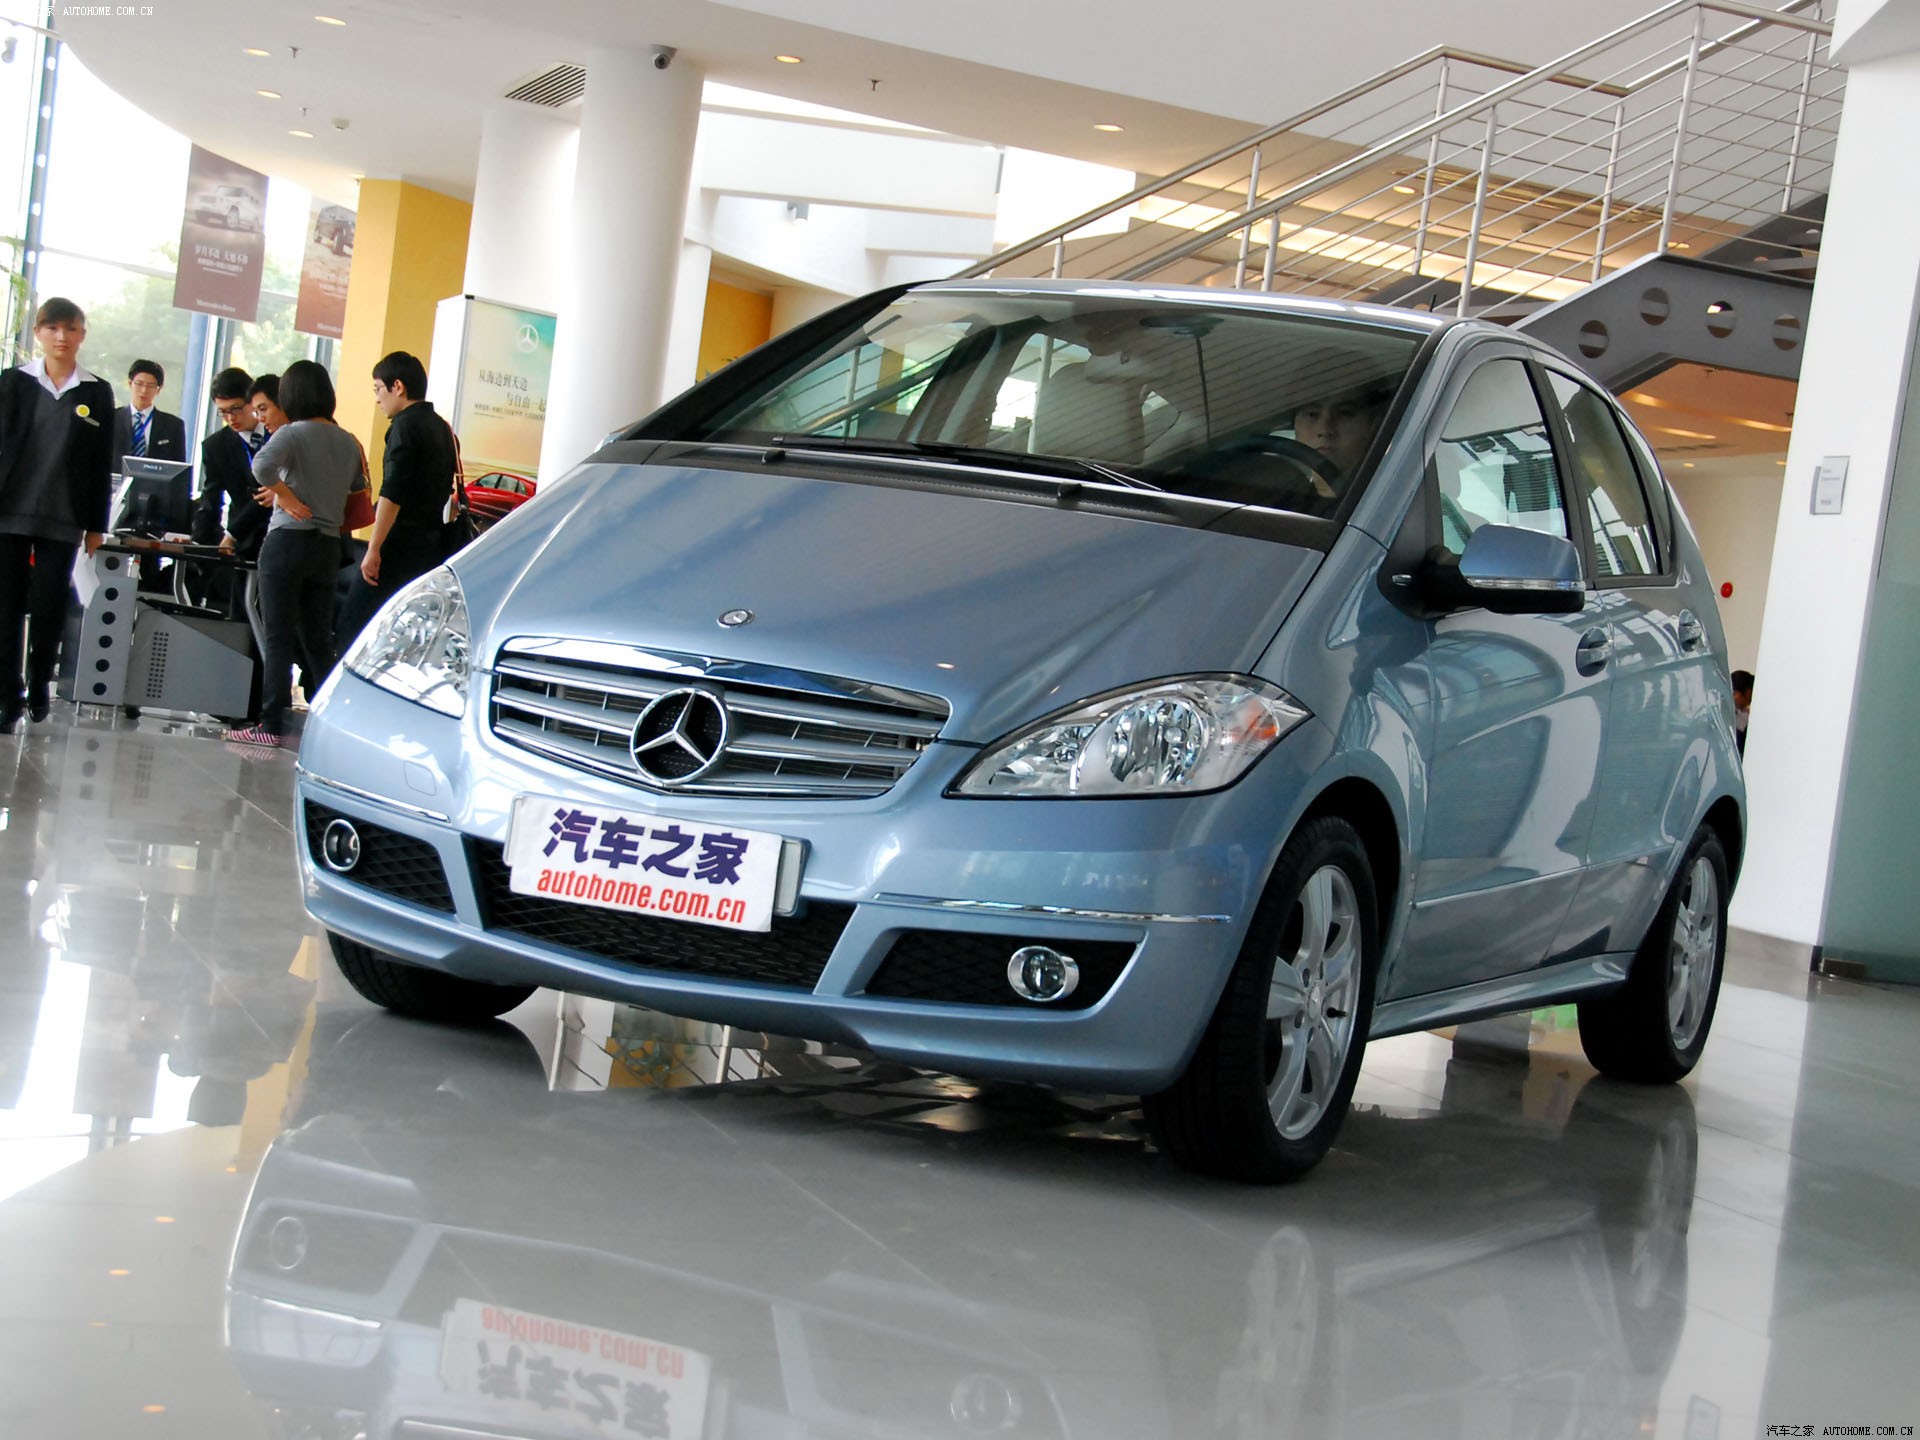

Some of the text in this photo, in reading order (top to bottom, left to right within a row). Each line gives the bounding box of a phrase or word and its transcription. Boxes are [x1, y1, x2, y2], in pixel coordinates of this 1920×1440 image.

[479, 368, 529, 392] 从海边到天边
[542, 807, 750, 886] 汽车之家
[537, 867, 746, 924] autohome.com.cn
